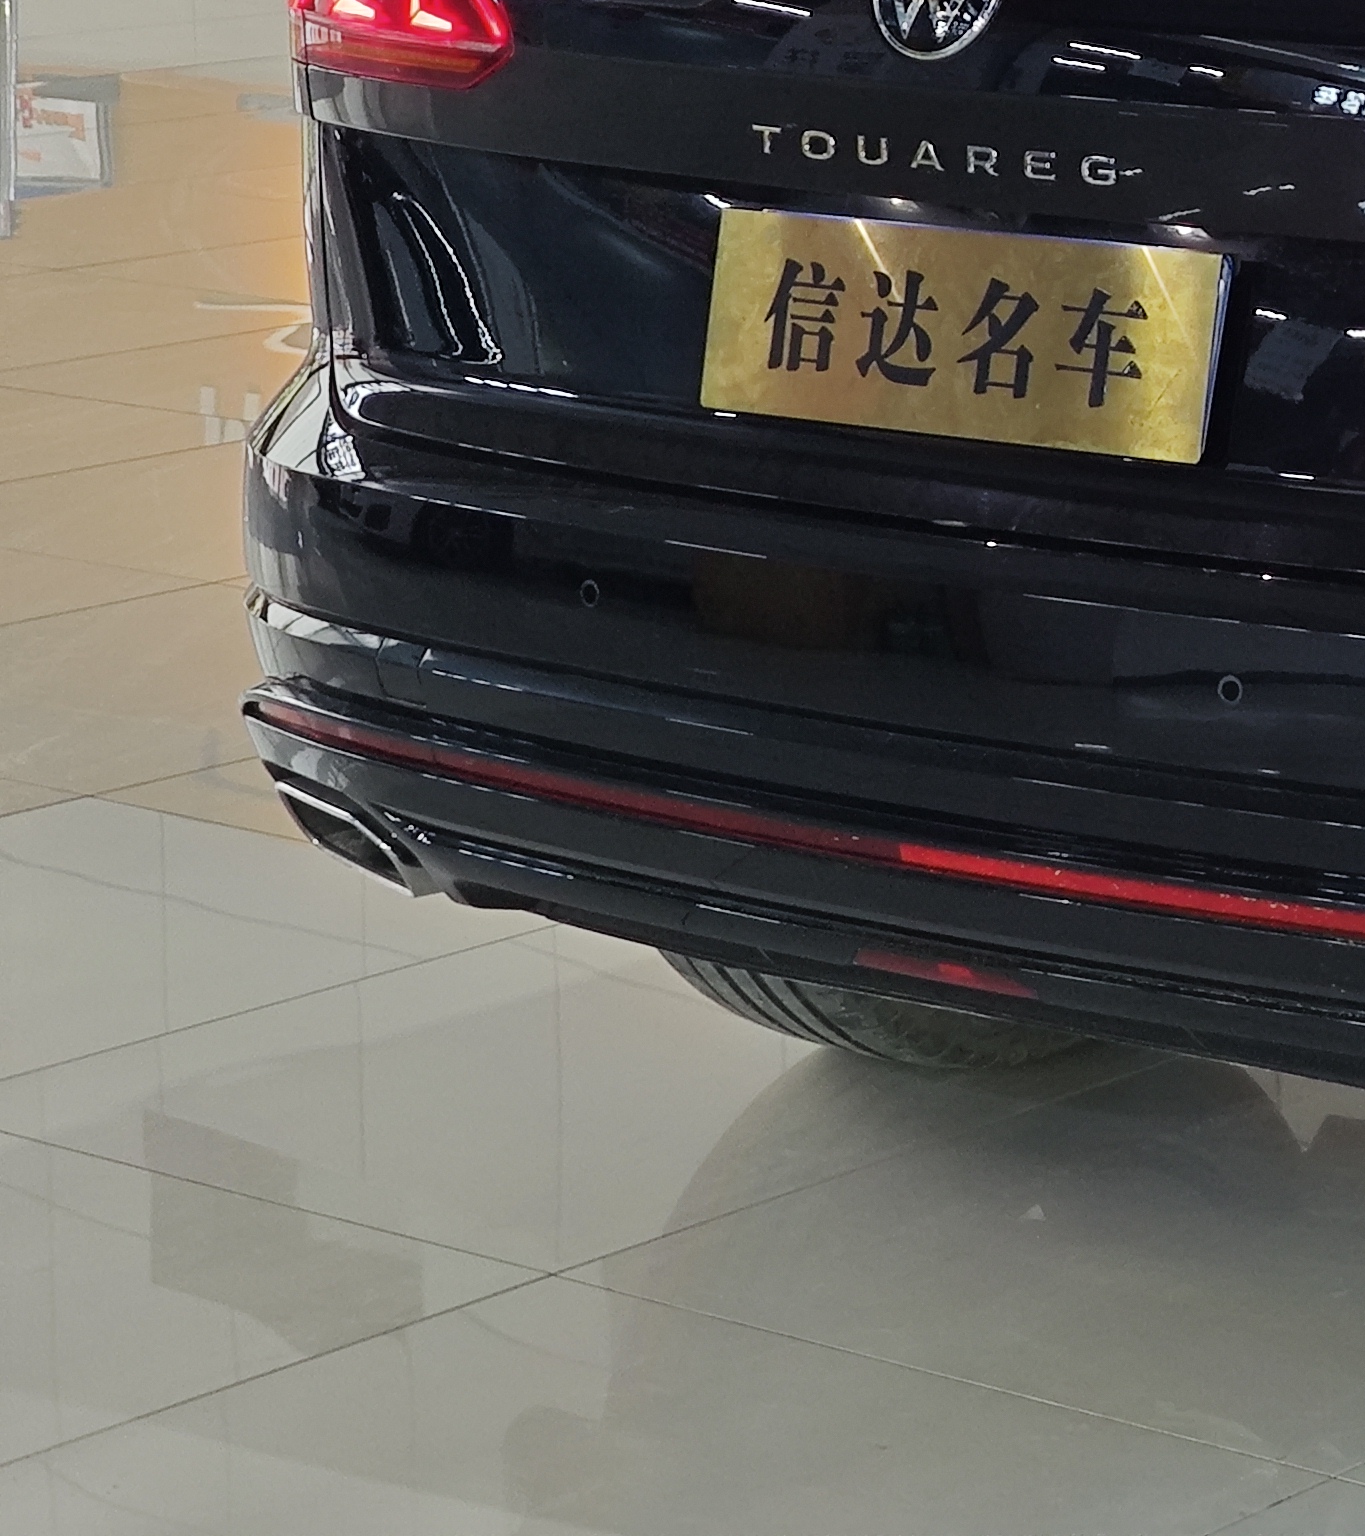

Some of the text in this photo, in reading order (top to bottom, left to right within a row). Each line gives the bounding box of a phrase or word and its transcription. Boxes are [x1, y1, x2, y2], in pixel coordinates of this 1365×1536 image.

[750, 122, 1119, 186] TOUAREG
[763, 257, 1149, 408] 信达名车
